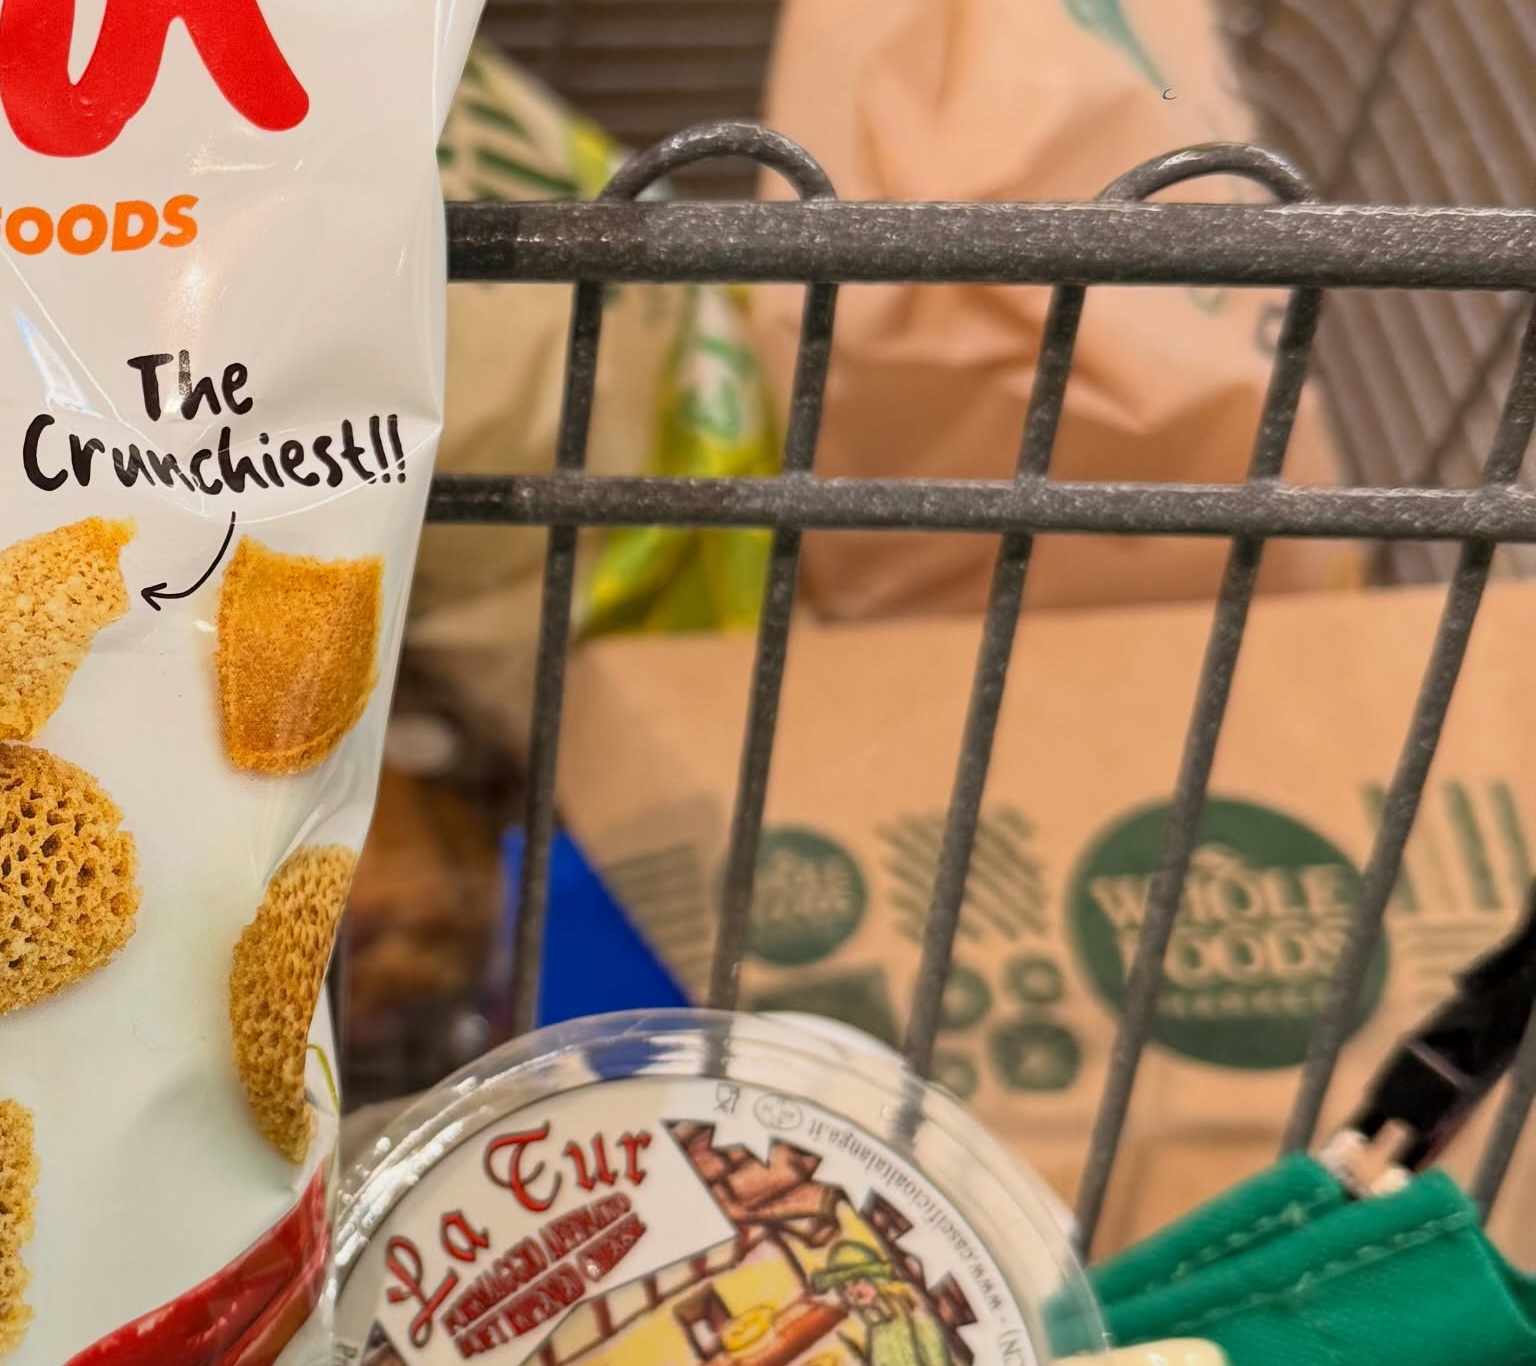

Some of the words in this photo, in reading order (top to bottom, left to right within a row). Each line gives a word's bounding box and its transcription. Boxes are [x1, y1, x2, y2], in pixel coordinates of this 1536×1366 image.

[127, 349, 254, 423] The
[22, 414, 408, 493] Crunchiest!!
[386, 1209, 490, 1348] La
[483, 1121, 652, 1212] Tur
